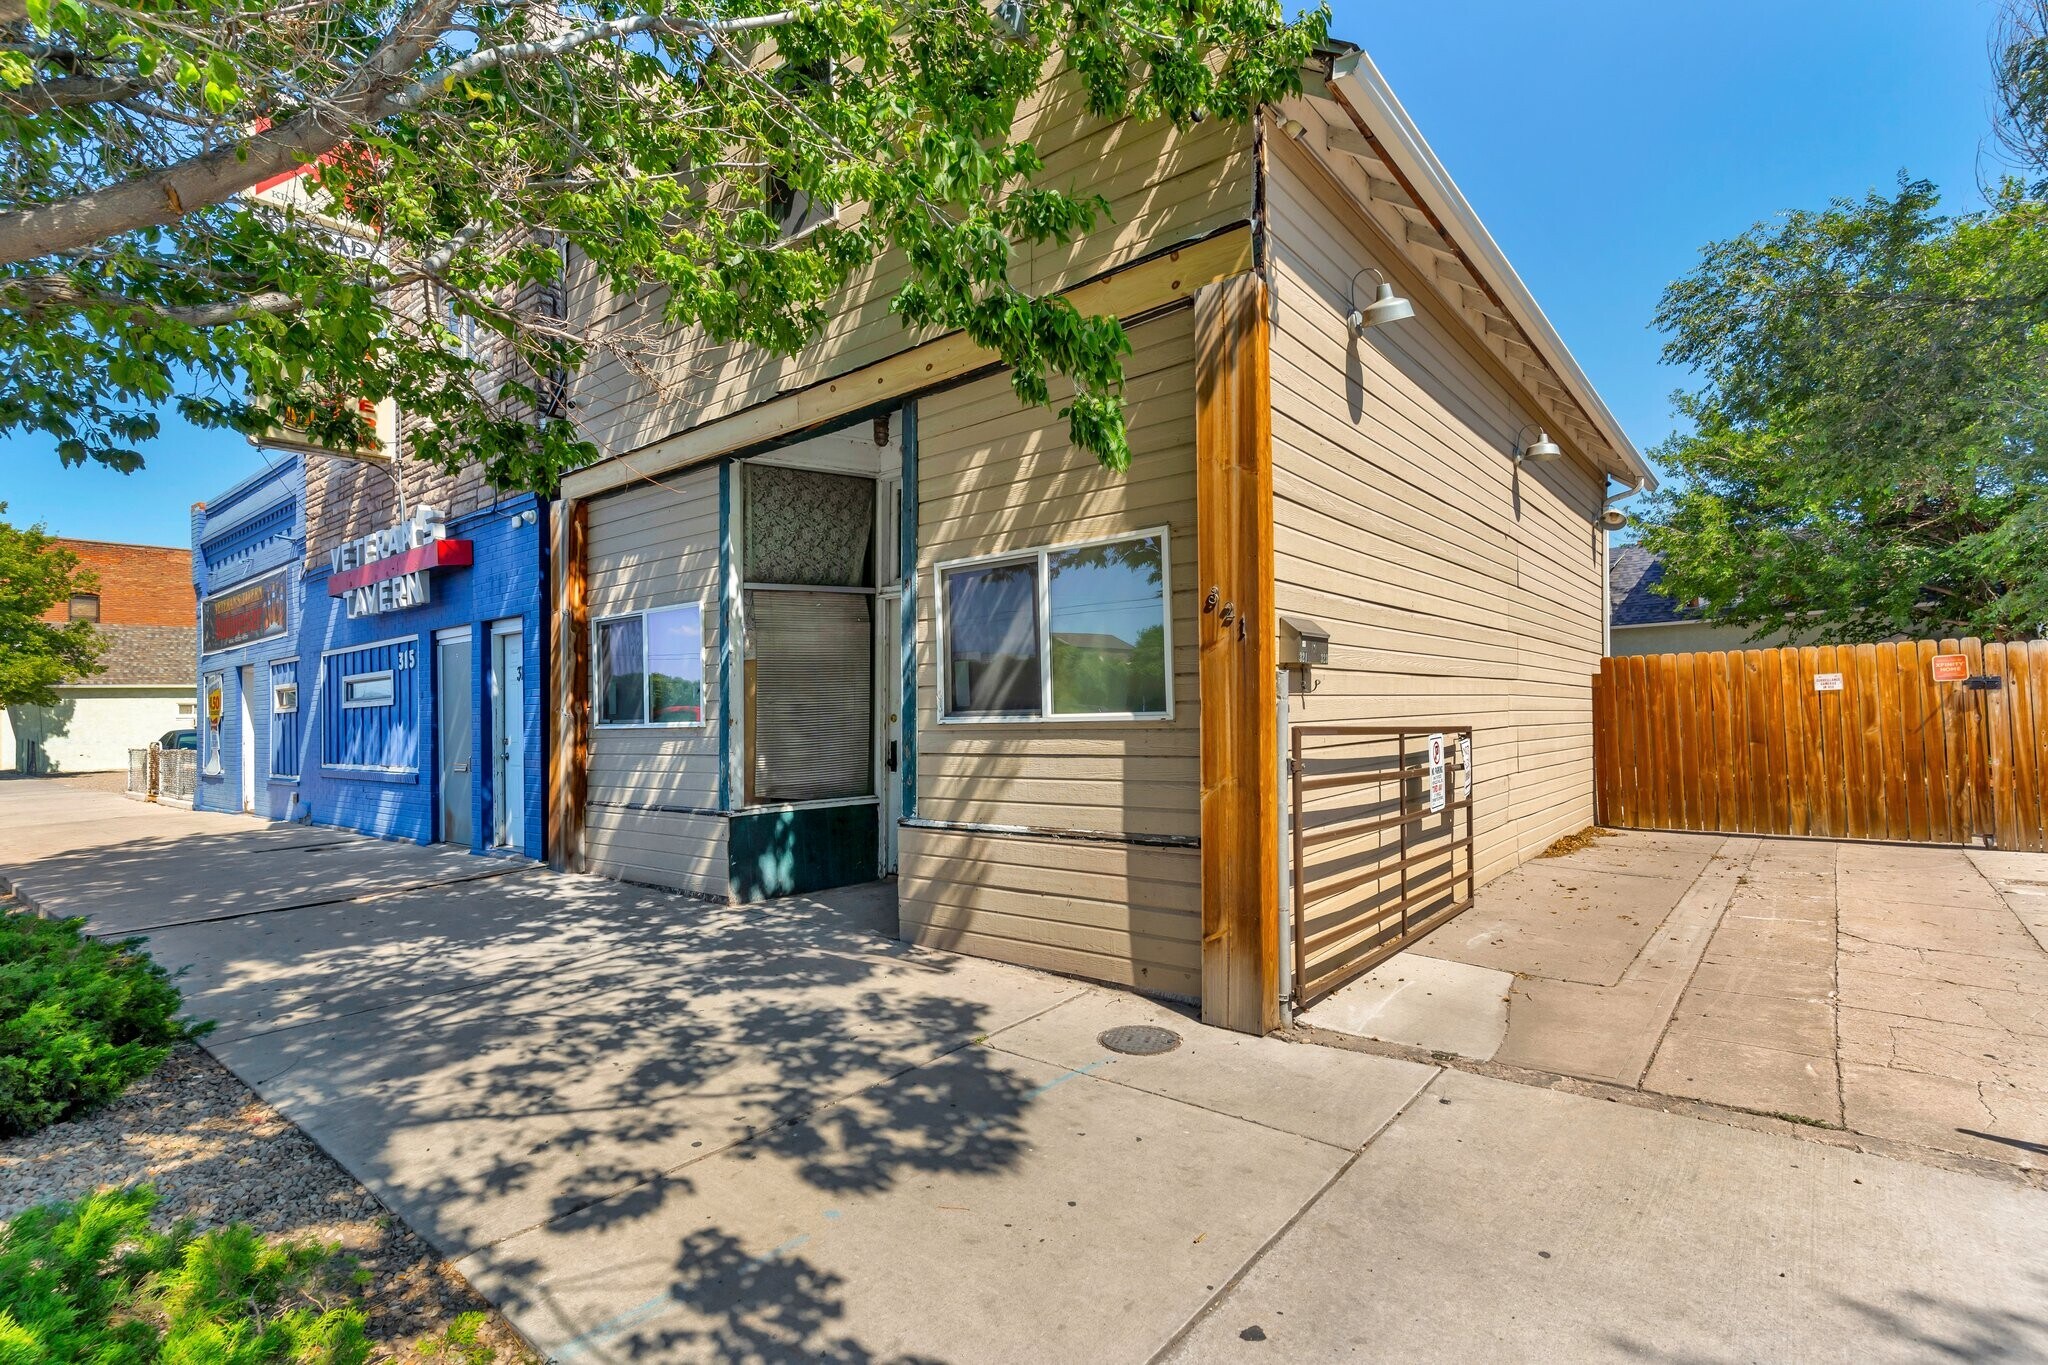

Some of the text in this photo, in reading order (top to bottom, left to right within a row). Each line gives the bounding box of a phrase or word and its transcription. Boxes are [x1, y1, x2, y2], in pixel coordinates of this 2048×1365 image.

[330, 504, 446, 575] VETERANS
[342, 570, 431, 619] TAVERN
[398, 649, 415, 671] 315
